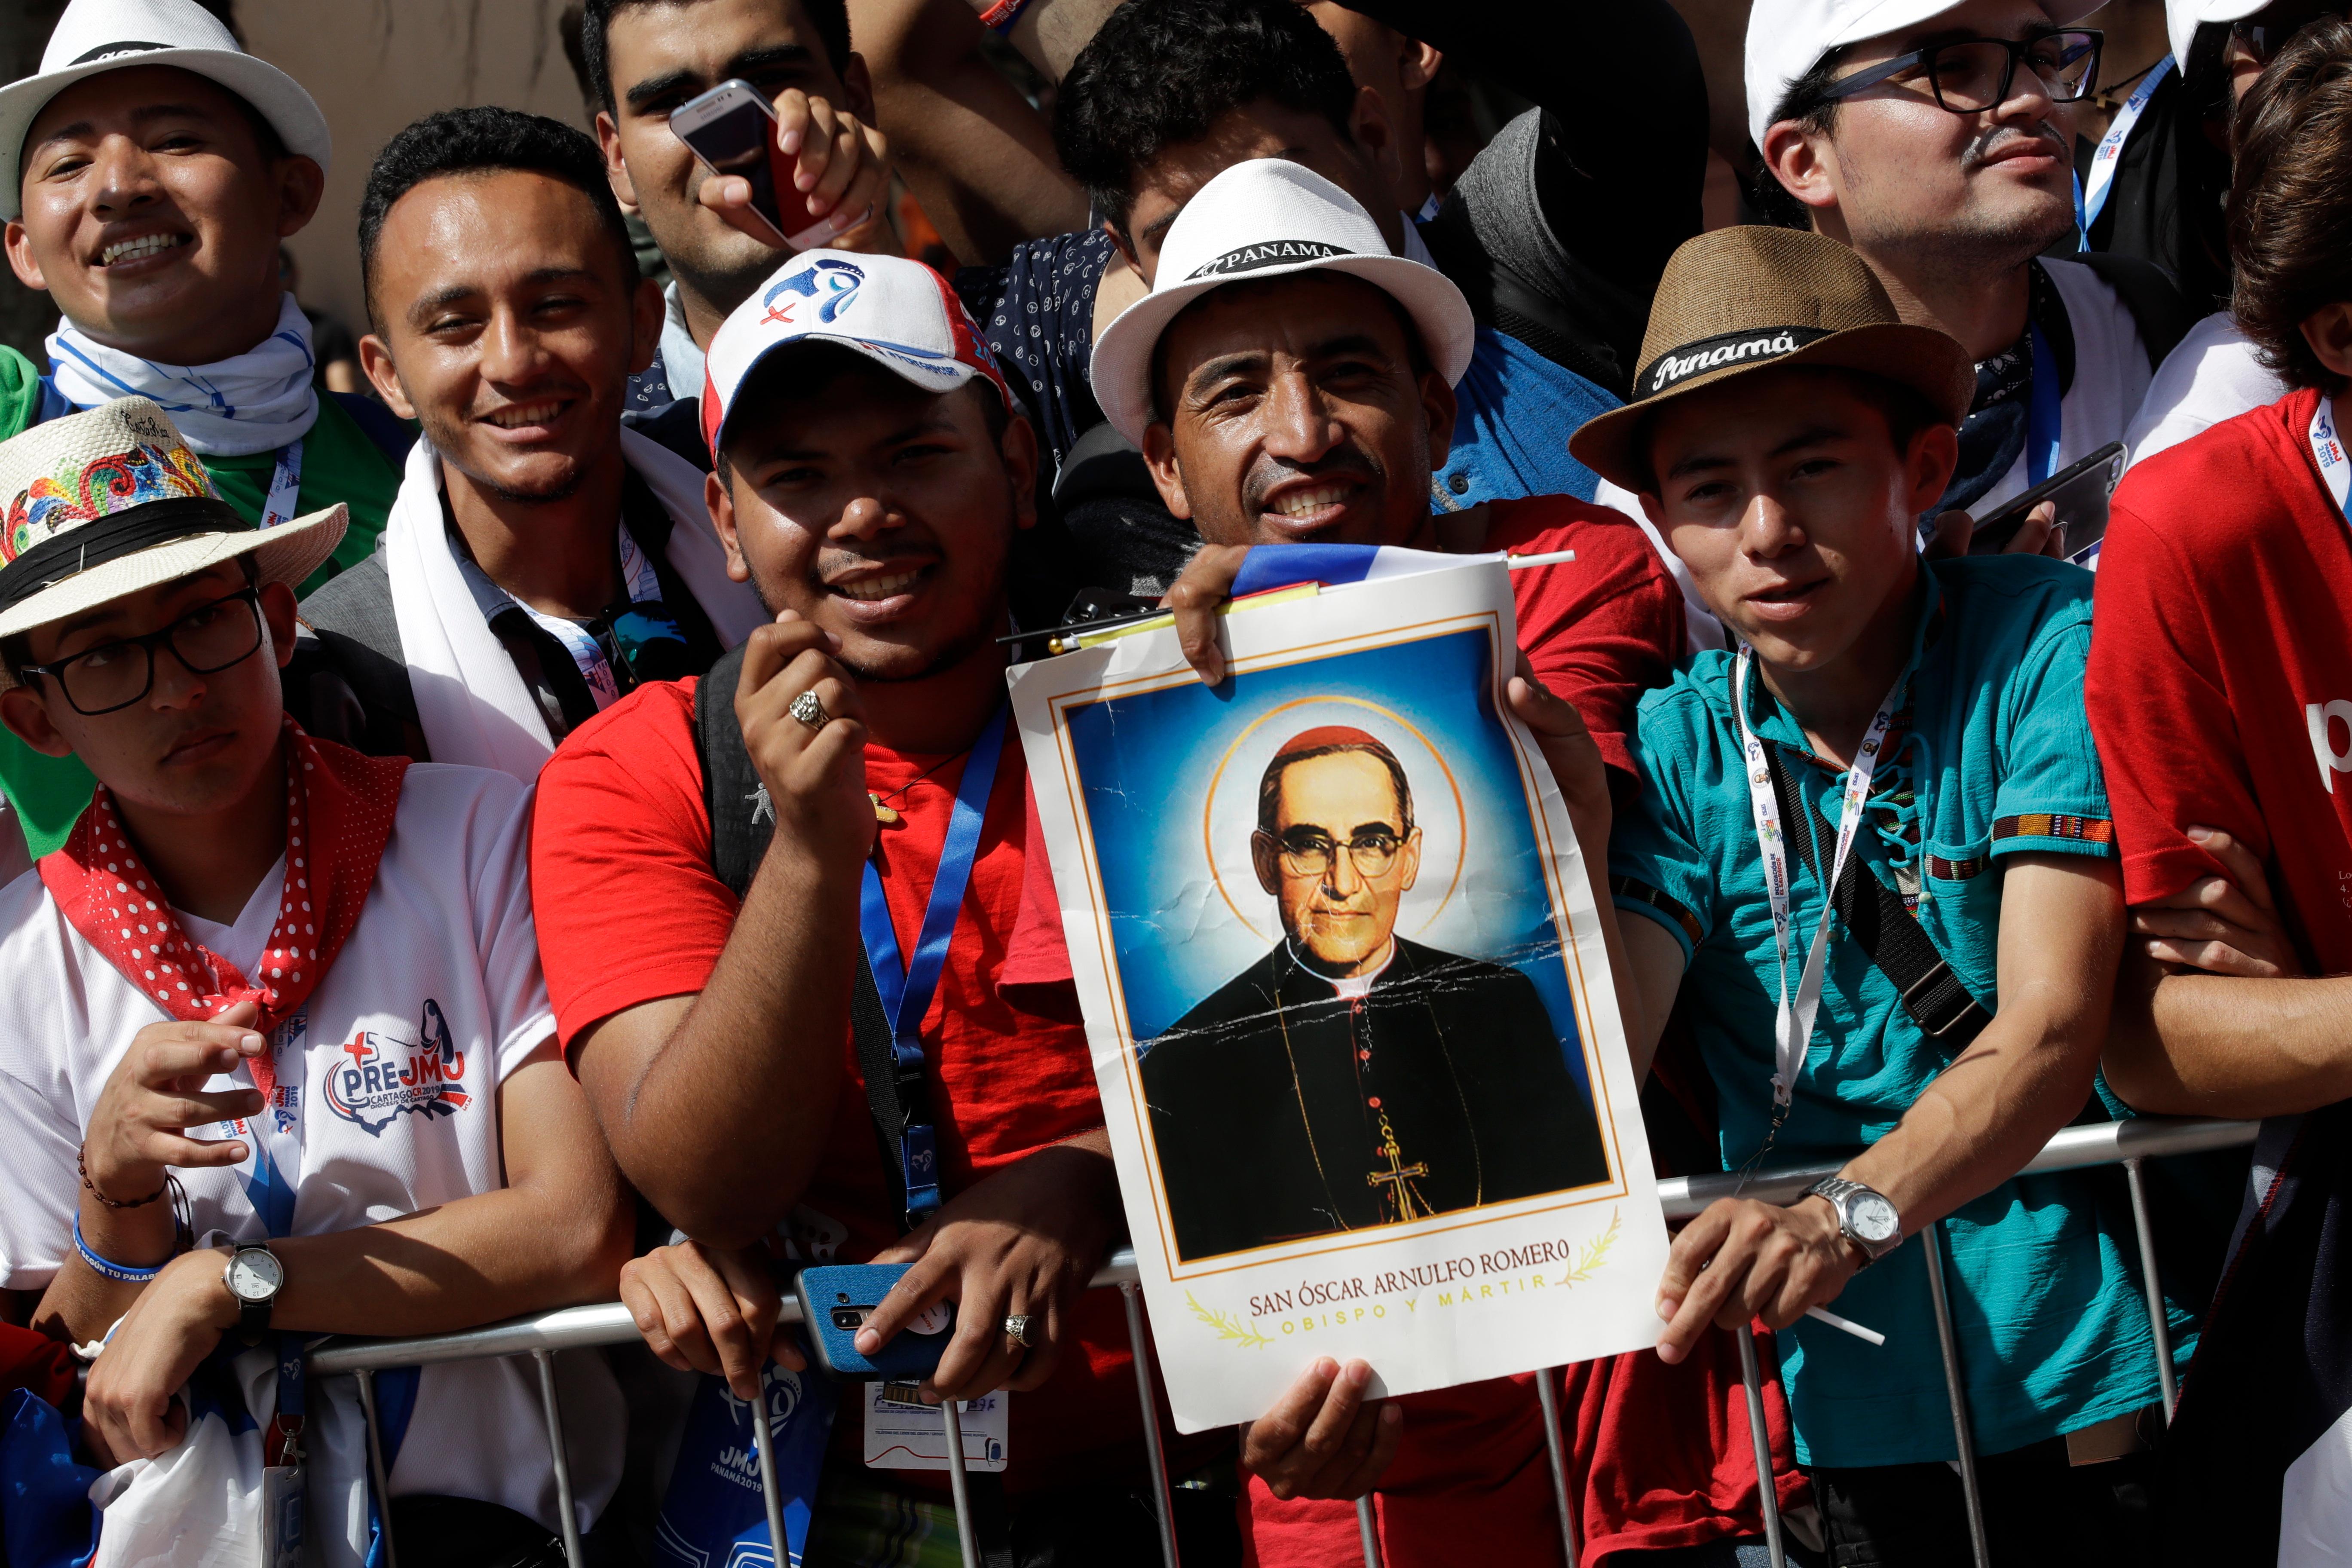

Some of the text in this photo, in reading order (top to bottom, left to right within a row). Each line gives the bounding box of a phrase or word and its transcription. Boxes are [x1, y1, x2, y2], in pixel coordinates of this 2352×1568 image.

[2097, 146, 2106, 160] 2019
[2107, 145, 2116, 159] JMJ
[1226, 243, 1333, 269] PANAMA
[1653, 331, 1799, 391] Panamá
[2318, 446, 2330, 468] 2019
[2329, 440, 2342, 461] JMJ
[2338, 871, 2352, 879] Lo
[2340, 884, 2349, 893] 4.
[276, 1085, 285, 1107] JMJ
[290, 1086, 298, 1107] 2019
[81, 1250, 106, 1273] SEGÚN
[108, 1268, 120, 1278] TU
[1250, 1239, 1569, 1317] SAN ÓSCAR ARNULFO ROMERO
[1282, 1274, 1546, 1334] OBISPO Y MÁRTIR
[720, 1446, 761, 1477] JMJ
